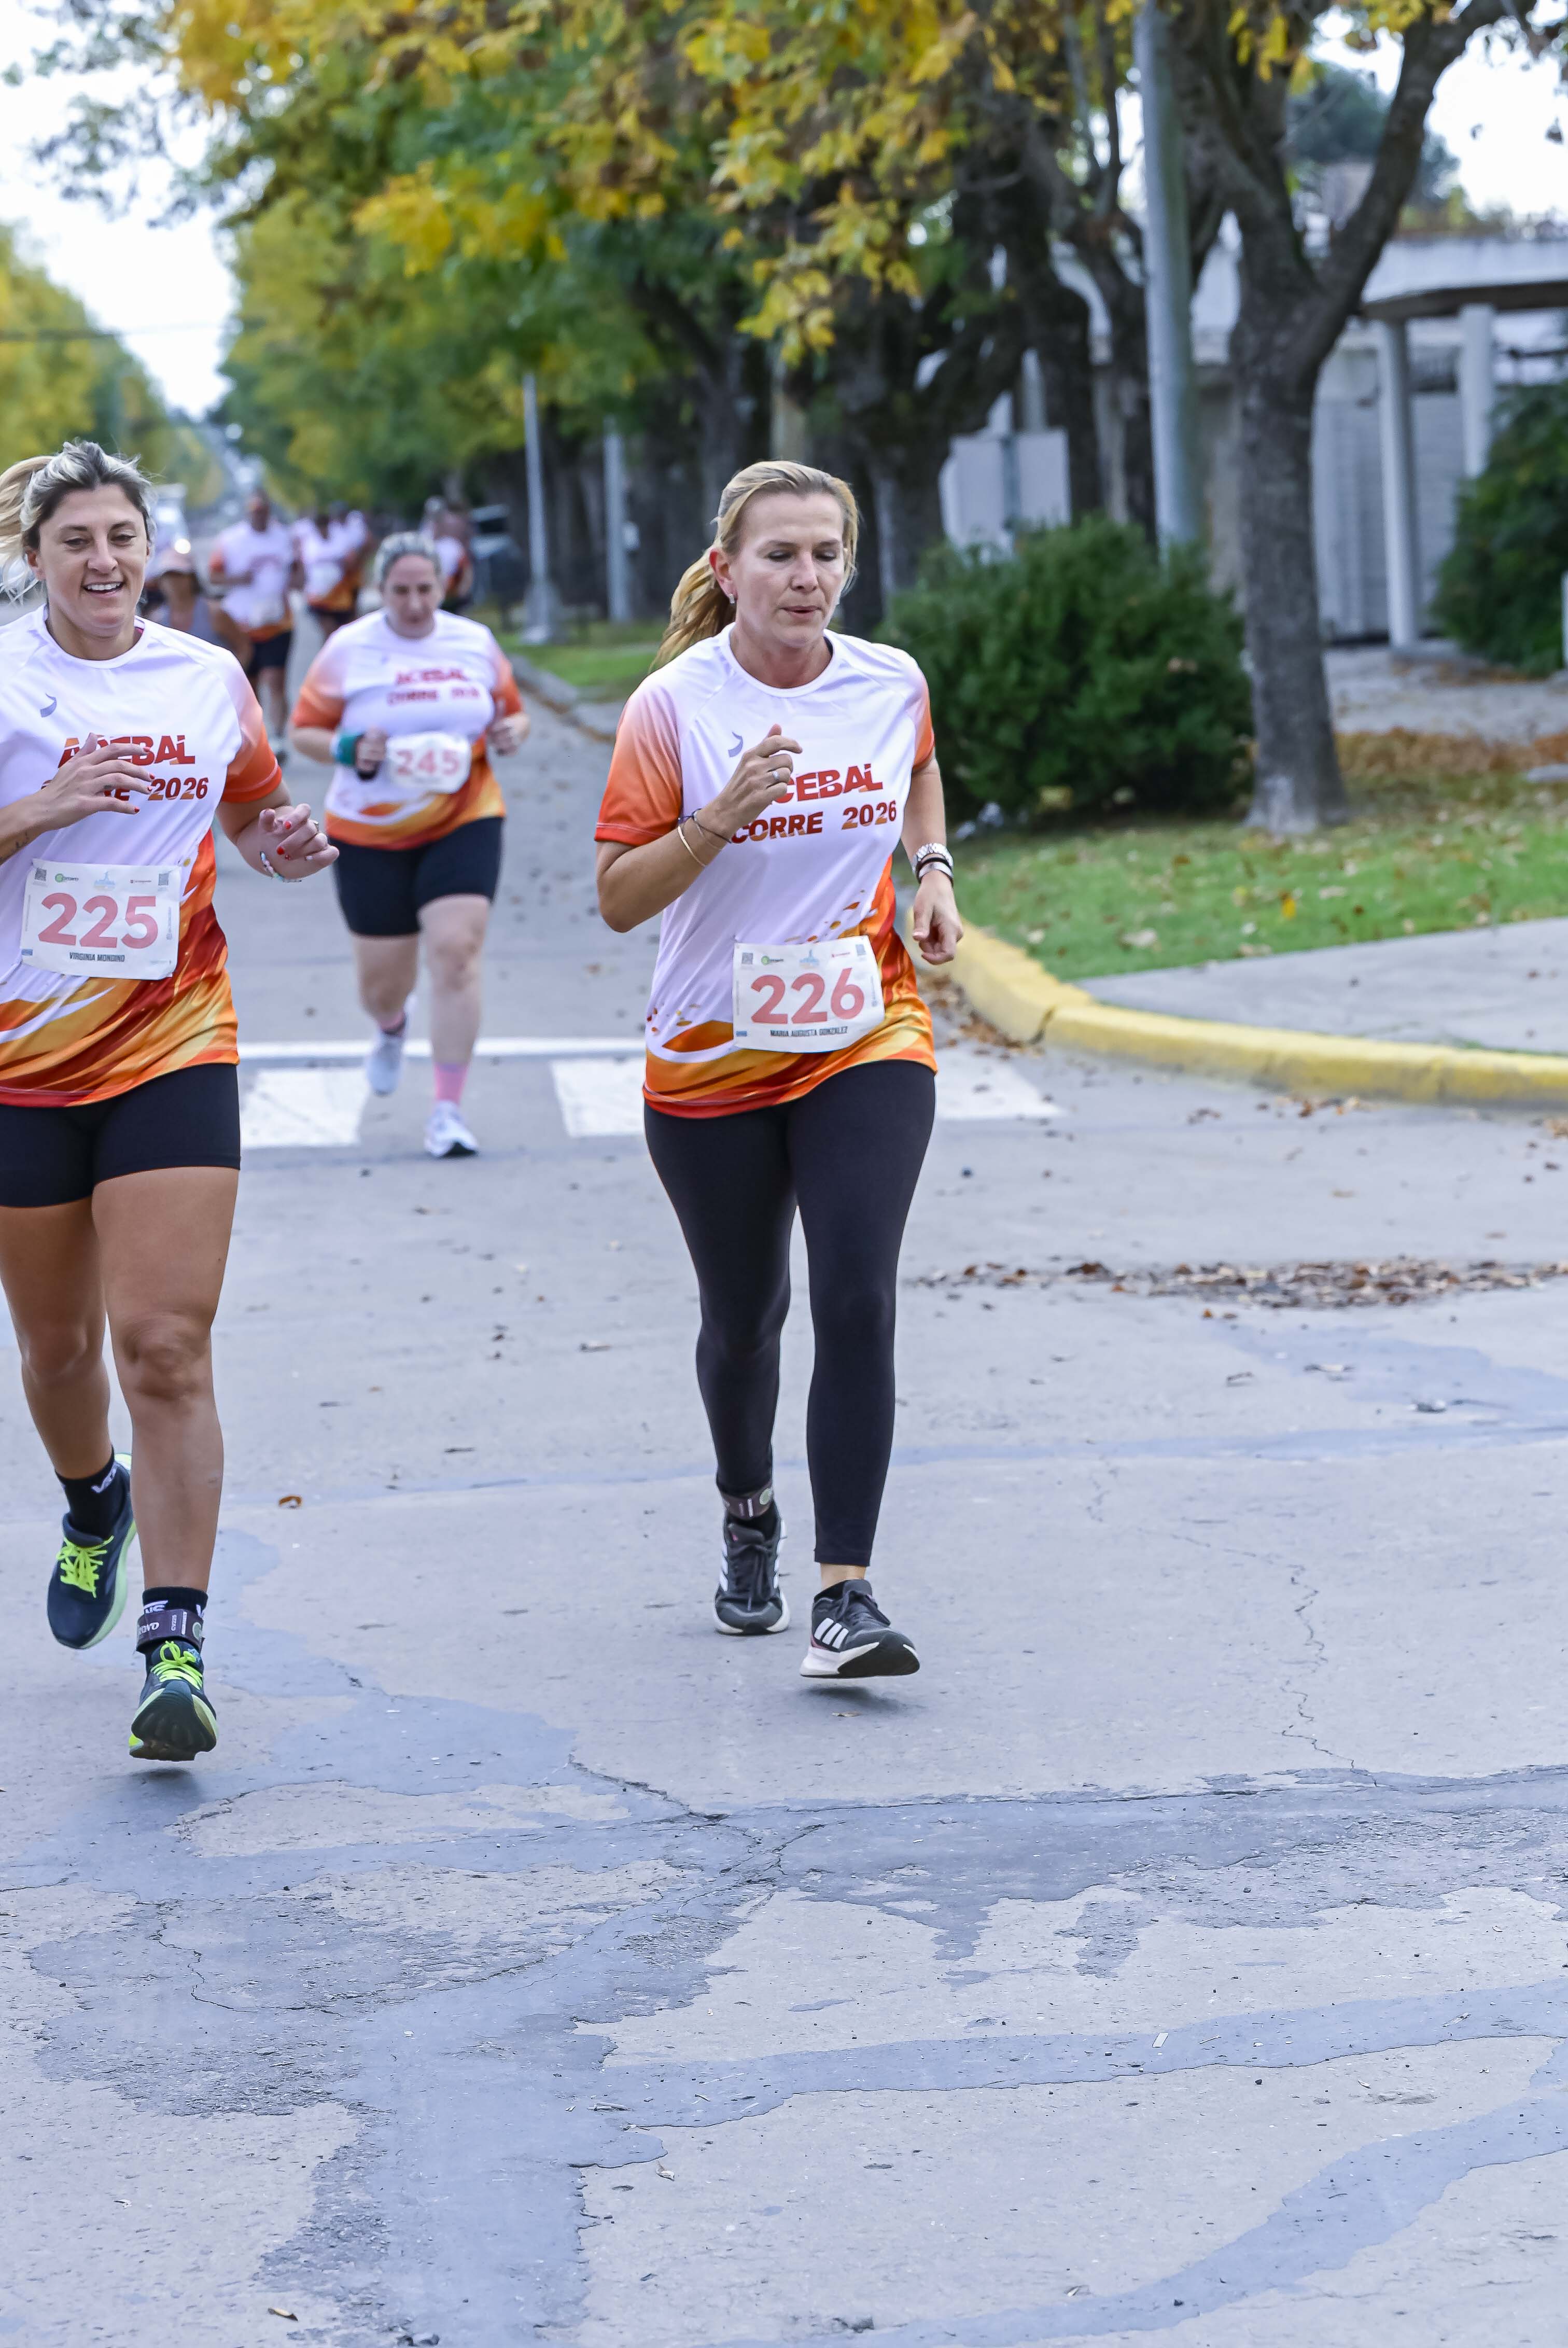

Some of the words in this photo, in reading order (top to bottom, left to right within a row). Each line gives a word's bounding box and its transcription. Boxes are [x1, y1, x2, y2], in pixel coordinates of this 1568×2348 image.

[58, 735, 195, 768] ABAL
[396, 749, 459, 776] 245
[148, 777, 209, 801] 2026
[776, 763, 884, 803] CEBAL
[731, 812, 823, 844] CORRE
[841, 800, 897, 830] 2026
[38, 892, 158, 949] 225
[69, 952, 95, 960] VIRGINIA
[751, 967, 865, 1025] 226
